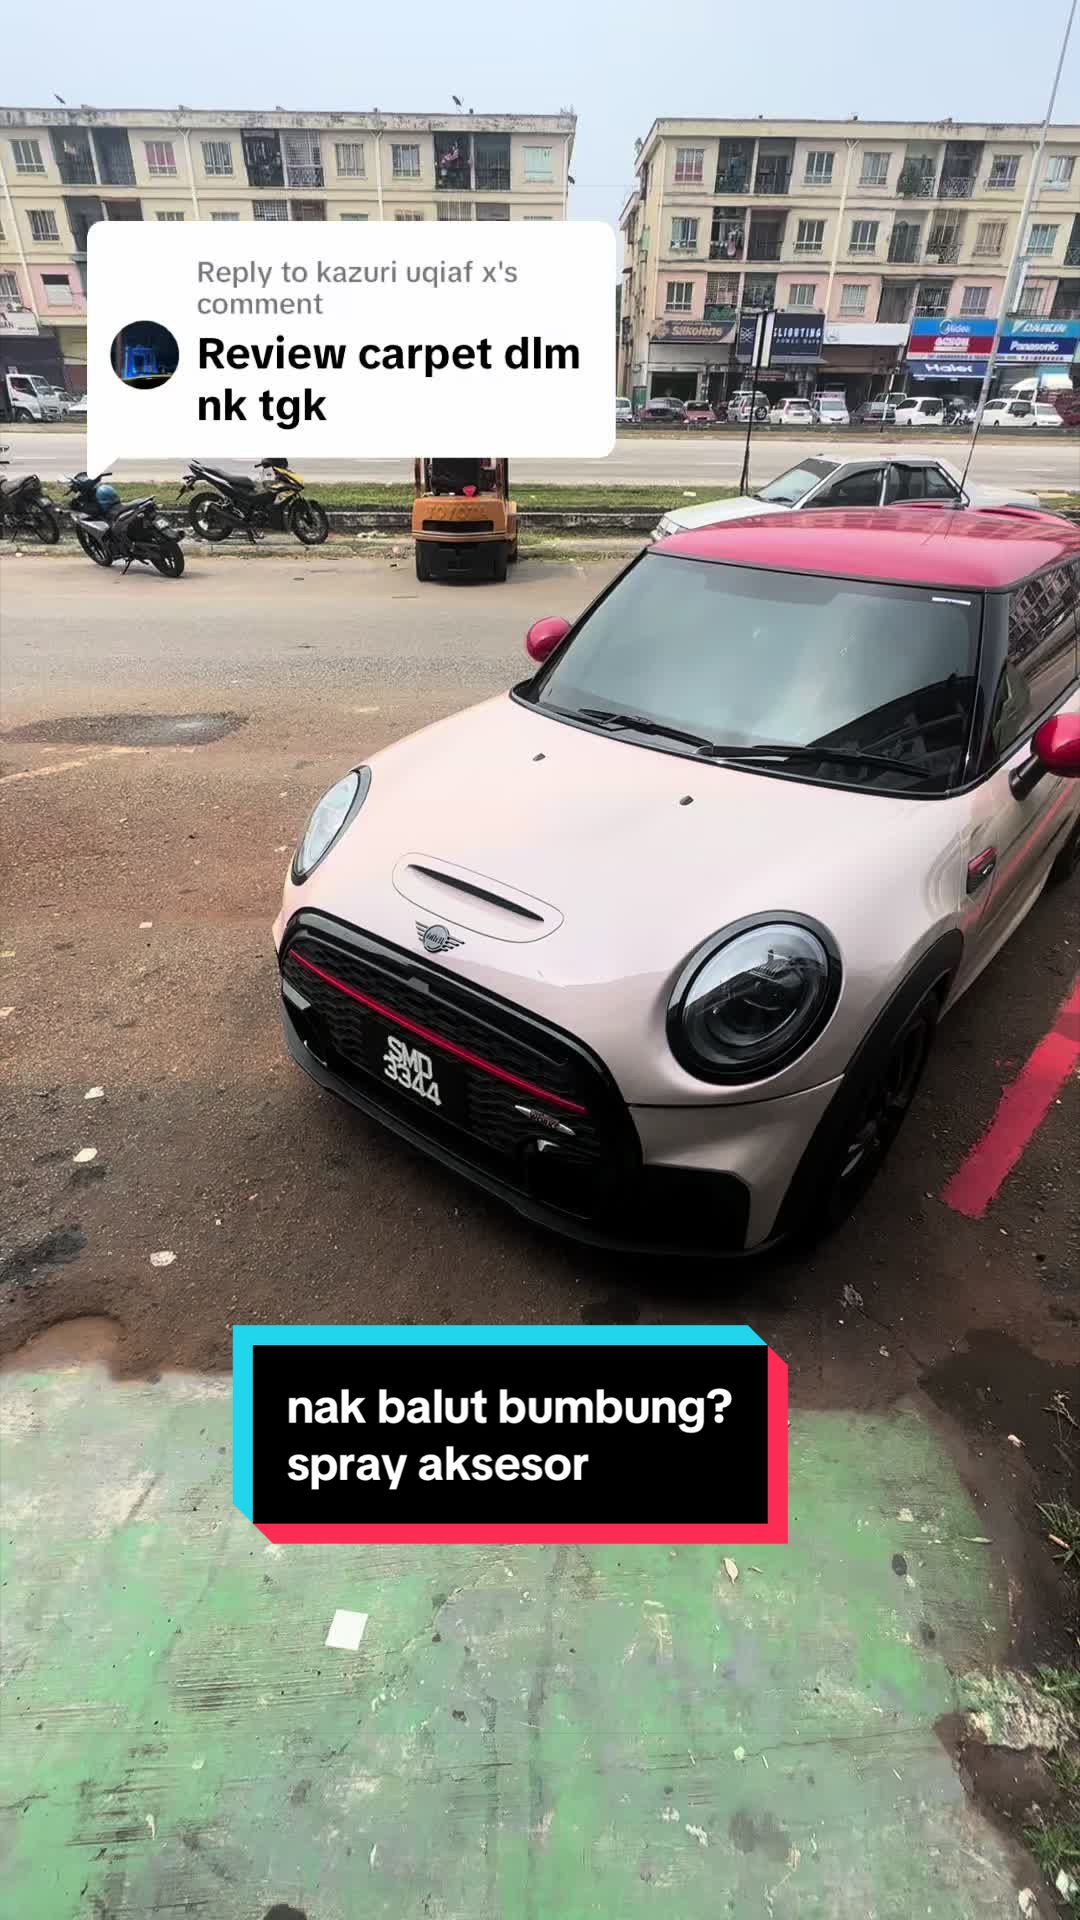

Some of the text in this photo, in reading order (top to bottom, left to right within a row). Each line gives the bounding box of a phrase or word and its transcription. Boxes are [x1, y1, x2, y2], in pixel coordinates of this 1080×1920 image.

[672, 326, 722, 336] Silkolene
[1023, 323, 1067, 333] DAIKIN
[1010, 340, 1060, 351] Panasonic
[924, 363, 972, 373] Haier
[386, 1035, 434, 1080] SMD
[382, 1053, 442, 1107] 3344
